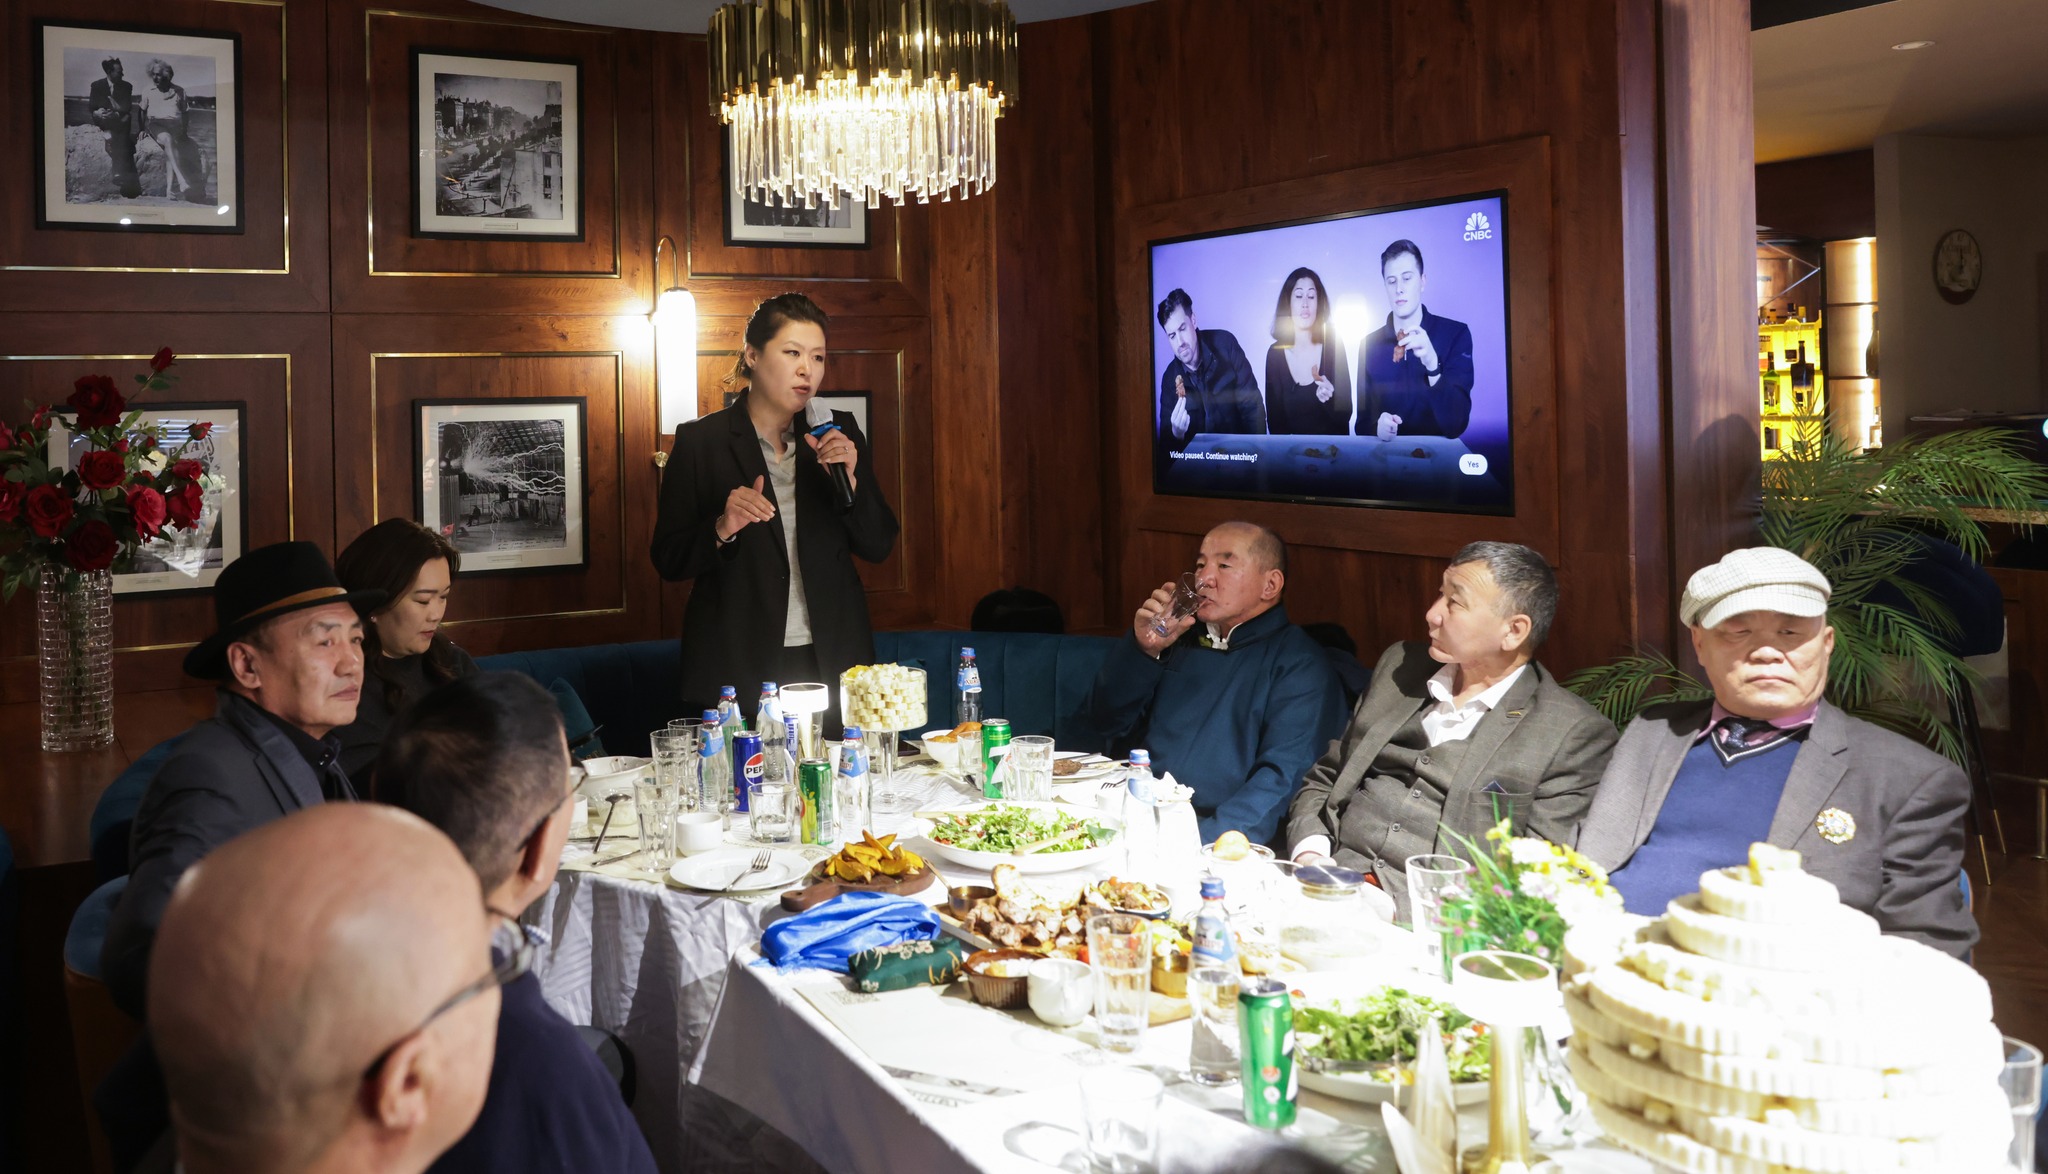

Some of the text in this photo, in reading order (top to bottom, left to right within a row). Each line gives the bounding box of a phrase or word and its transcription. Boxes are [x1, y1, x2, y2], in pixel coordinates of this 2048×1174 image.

[1463, 229, 1492, 242] CNBC
[1169, 451, 1258, 463] Video paused. Continue watching?
